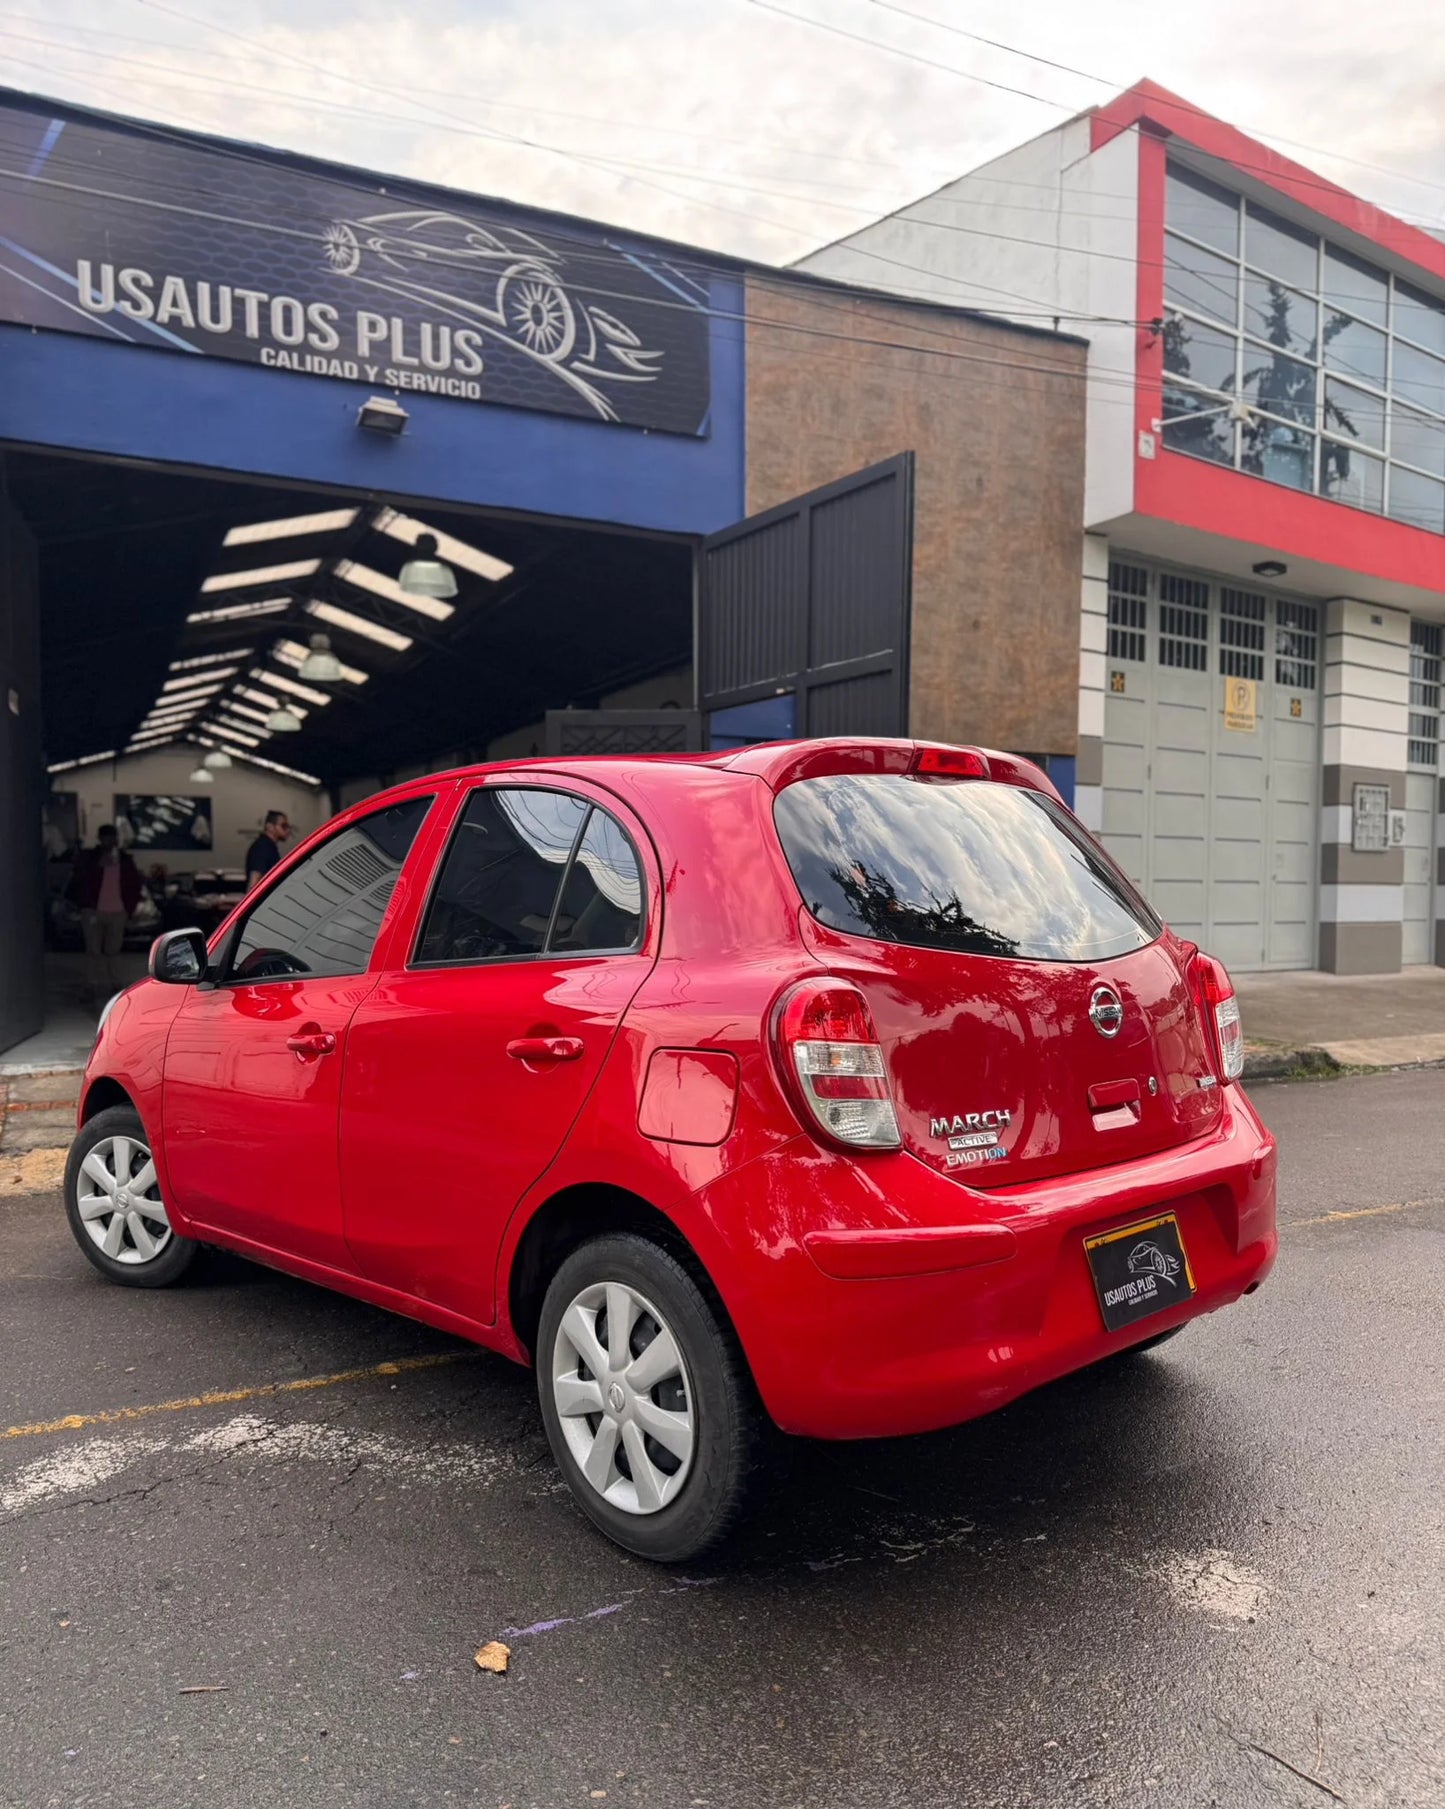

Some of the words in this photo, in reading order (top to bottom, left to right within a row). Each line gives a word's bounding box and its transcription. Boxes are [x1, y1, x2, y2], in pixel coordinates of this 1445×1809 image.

[77, 259, 340, 352] USAUTOS
[356, 310, 484, 376] PLUS
[260, 347, 359, 380] CALIDAD
[364, 365, 379, 383] Y
[385, 368, 481, 399] SERVICIO
[930, 1109, 1011, 1137] MARCH
[957, 1134, 992, 1146] ACTIVE
[946, 1146, 1007, 1167] EMOTION
[1104, 1281, 1138, 1307] USAUTOS
[1136, 1274, 1156, 1293] PLUS
